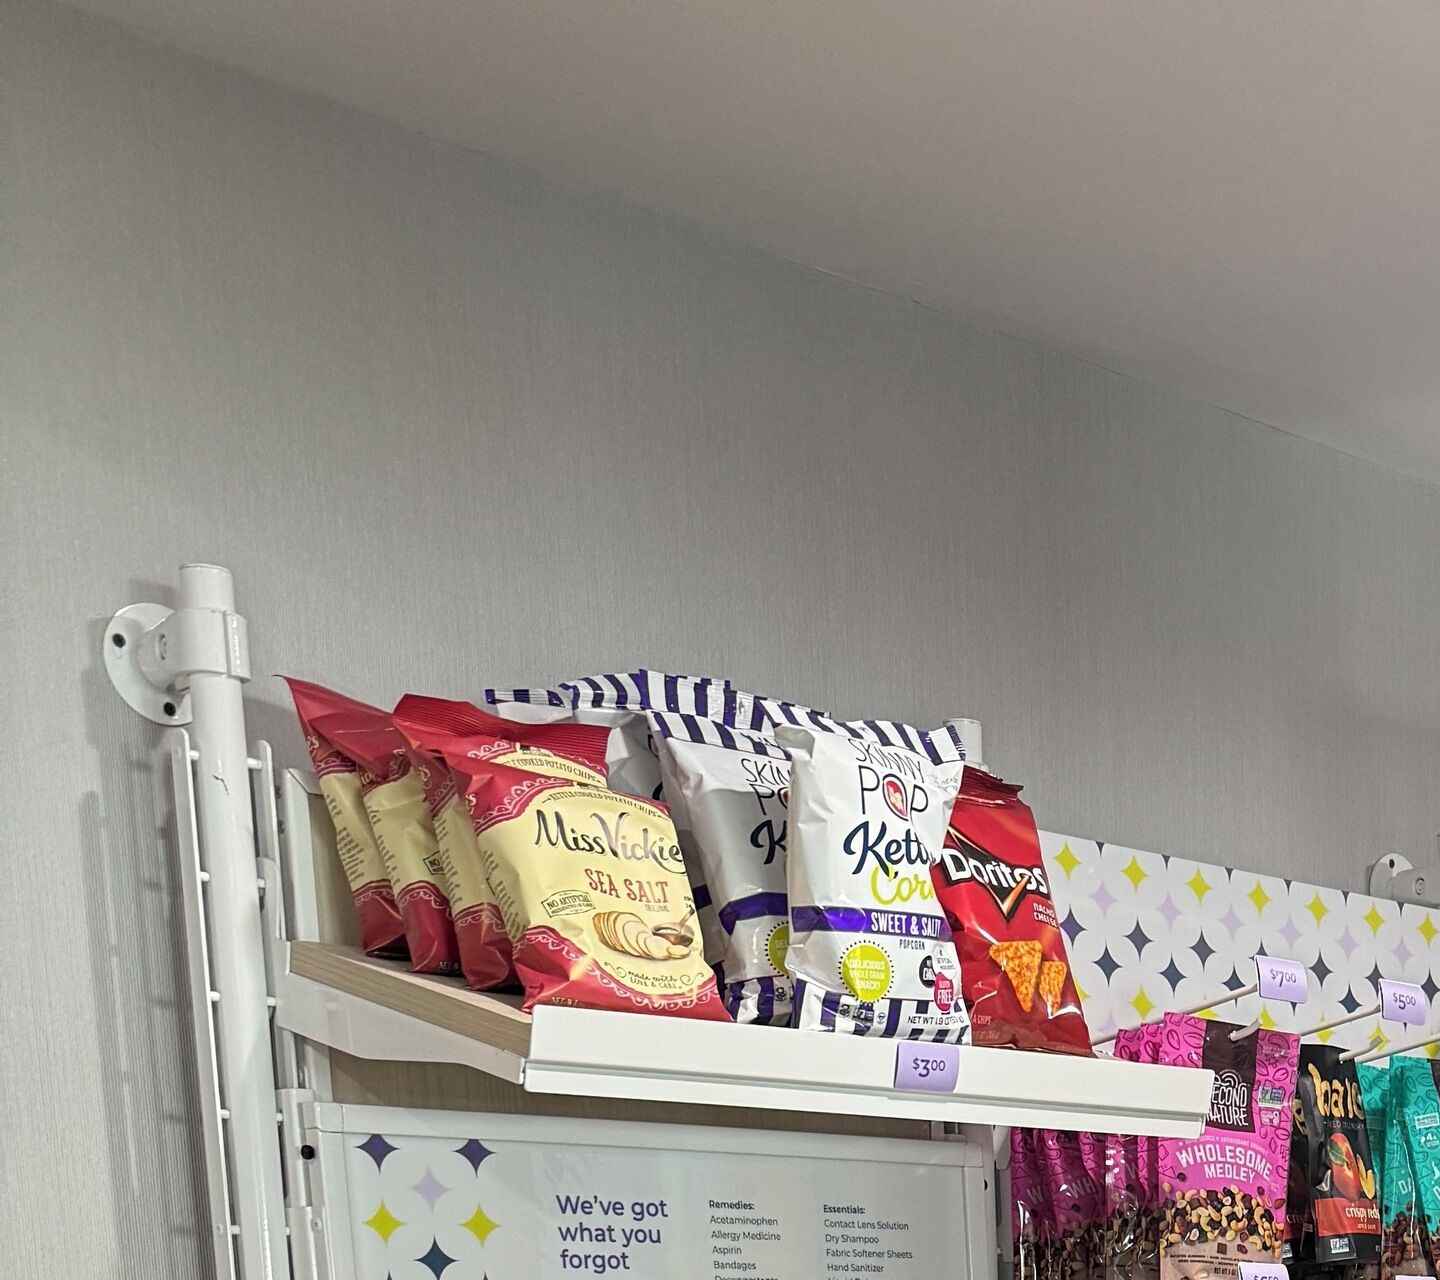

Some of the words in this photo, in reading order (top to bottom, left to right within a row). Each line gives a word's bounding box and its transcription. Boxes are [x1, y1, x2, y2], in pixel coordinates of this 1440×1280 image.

[847, 737, 925, 784] SKINNY
[858, 765, 929, 822] POP
[534, 808, 604, 855] Miss
[590, 811, 687, 874] Vickie
[940, 847, 1048, 894] Doritos
[584, 867, 622, 899] SEA
[623, 877, 669, 904] SALT
[870, 911, 907, 935] SWEET
[909, 915, 920, 935] &
[1033, 911, 1058, 927] CHEESE
[898, 938, 926, 951] POPCORN
[1175, 1143, 1273, 1182] WHOLESOME
[1204, 1163, 1256, 1184] MEDLEY
[556, 1194, 625, 1216] We've
[631, 1199, 669, 1221] got
[708, 1199, 755, 1210] Remedies:
[823, 1204, 866, 1214] Essentials:
[709, 1215, 779, 1226] Acetaminophen
[824, 1219, 856, 1229] Contact
[857, 1220, 876, 1229] Lens
[876, 1220, 909, 1230] Solution
[558, 1222, 617, 1243] what
[621, 1227, 662, 1248] you
[711, 1230, 741, 1241] Allergy
[742, 1231, 781, 1241] Medicine
[825, 1233, 839, 1244] Dry
[841, 1234, 880, 1245] Shampoo
[712, 1245, 742, 1256] Aspirin
[826, 1248, 851, 1258] Fabric
[852, 1248, 885, 1258] Softener
[886, 1249, 913, 1259] Sheets
[560, 1248, 631, 1275] forgot
[713, 1260, 757, 1272] Bandages
[827, 1263, 849, 1272] Hand
[850, 1263, 884, 1273] Sanitizer
